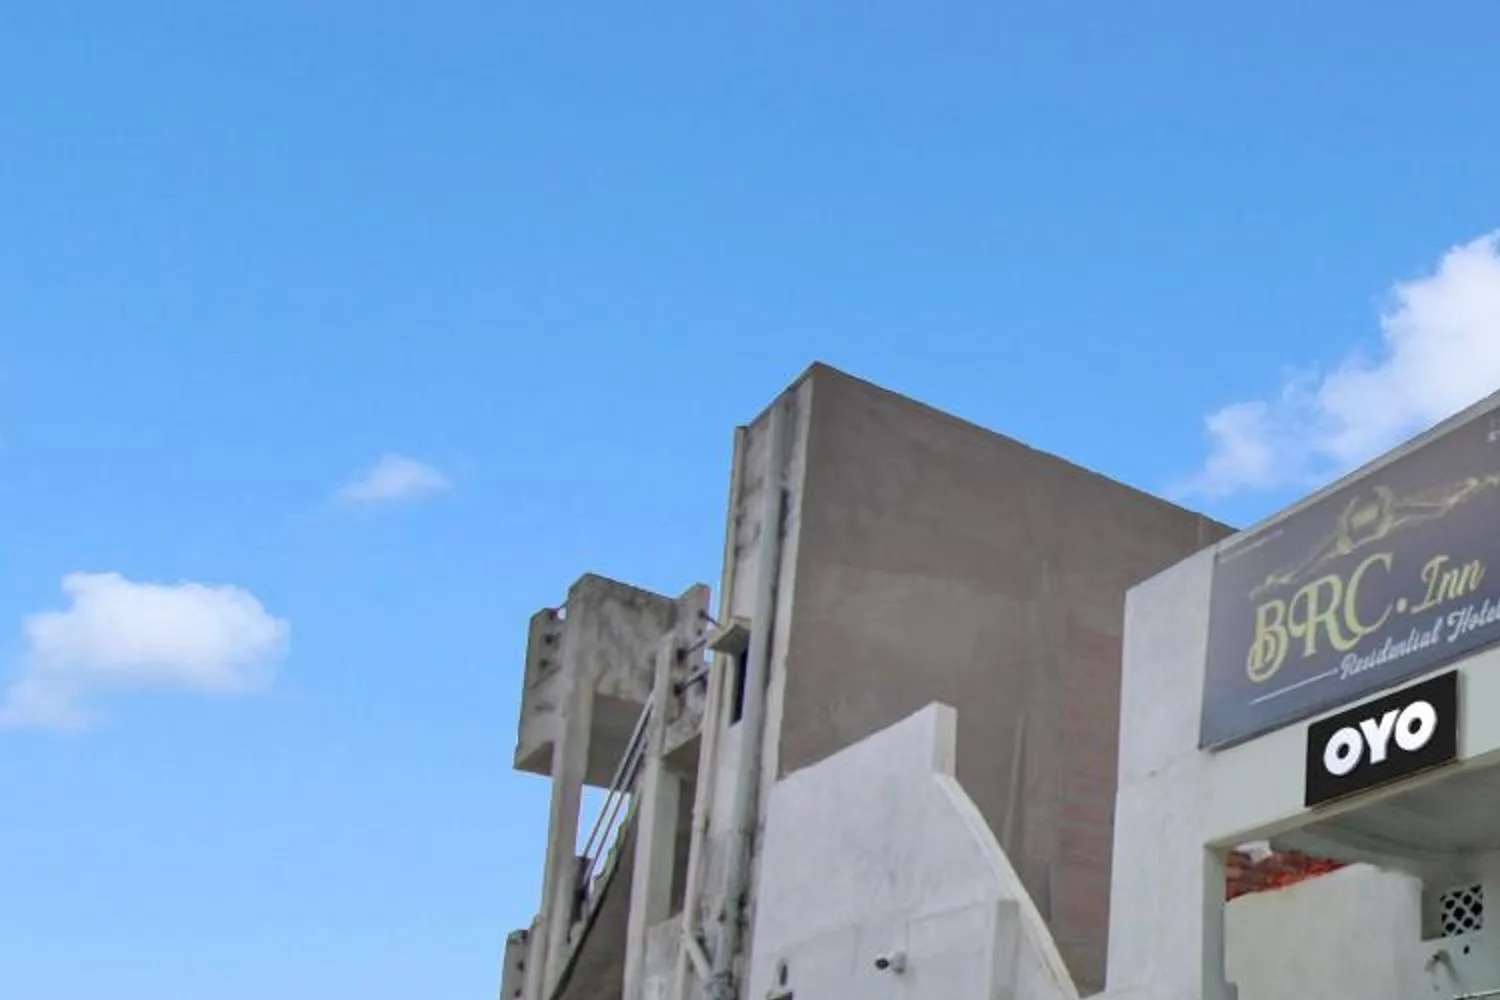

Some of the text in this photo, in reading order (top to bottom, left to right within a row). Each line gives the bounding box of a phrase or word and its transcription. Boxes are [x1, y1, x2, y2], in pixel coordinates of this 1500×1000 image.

[1410, 554, 1487, 614] Inn
[1339, 617, 1446, 680] Residential
[1323, 700, 1438, 776] OYO
